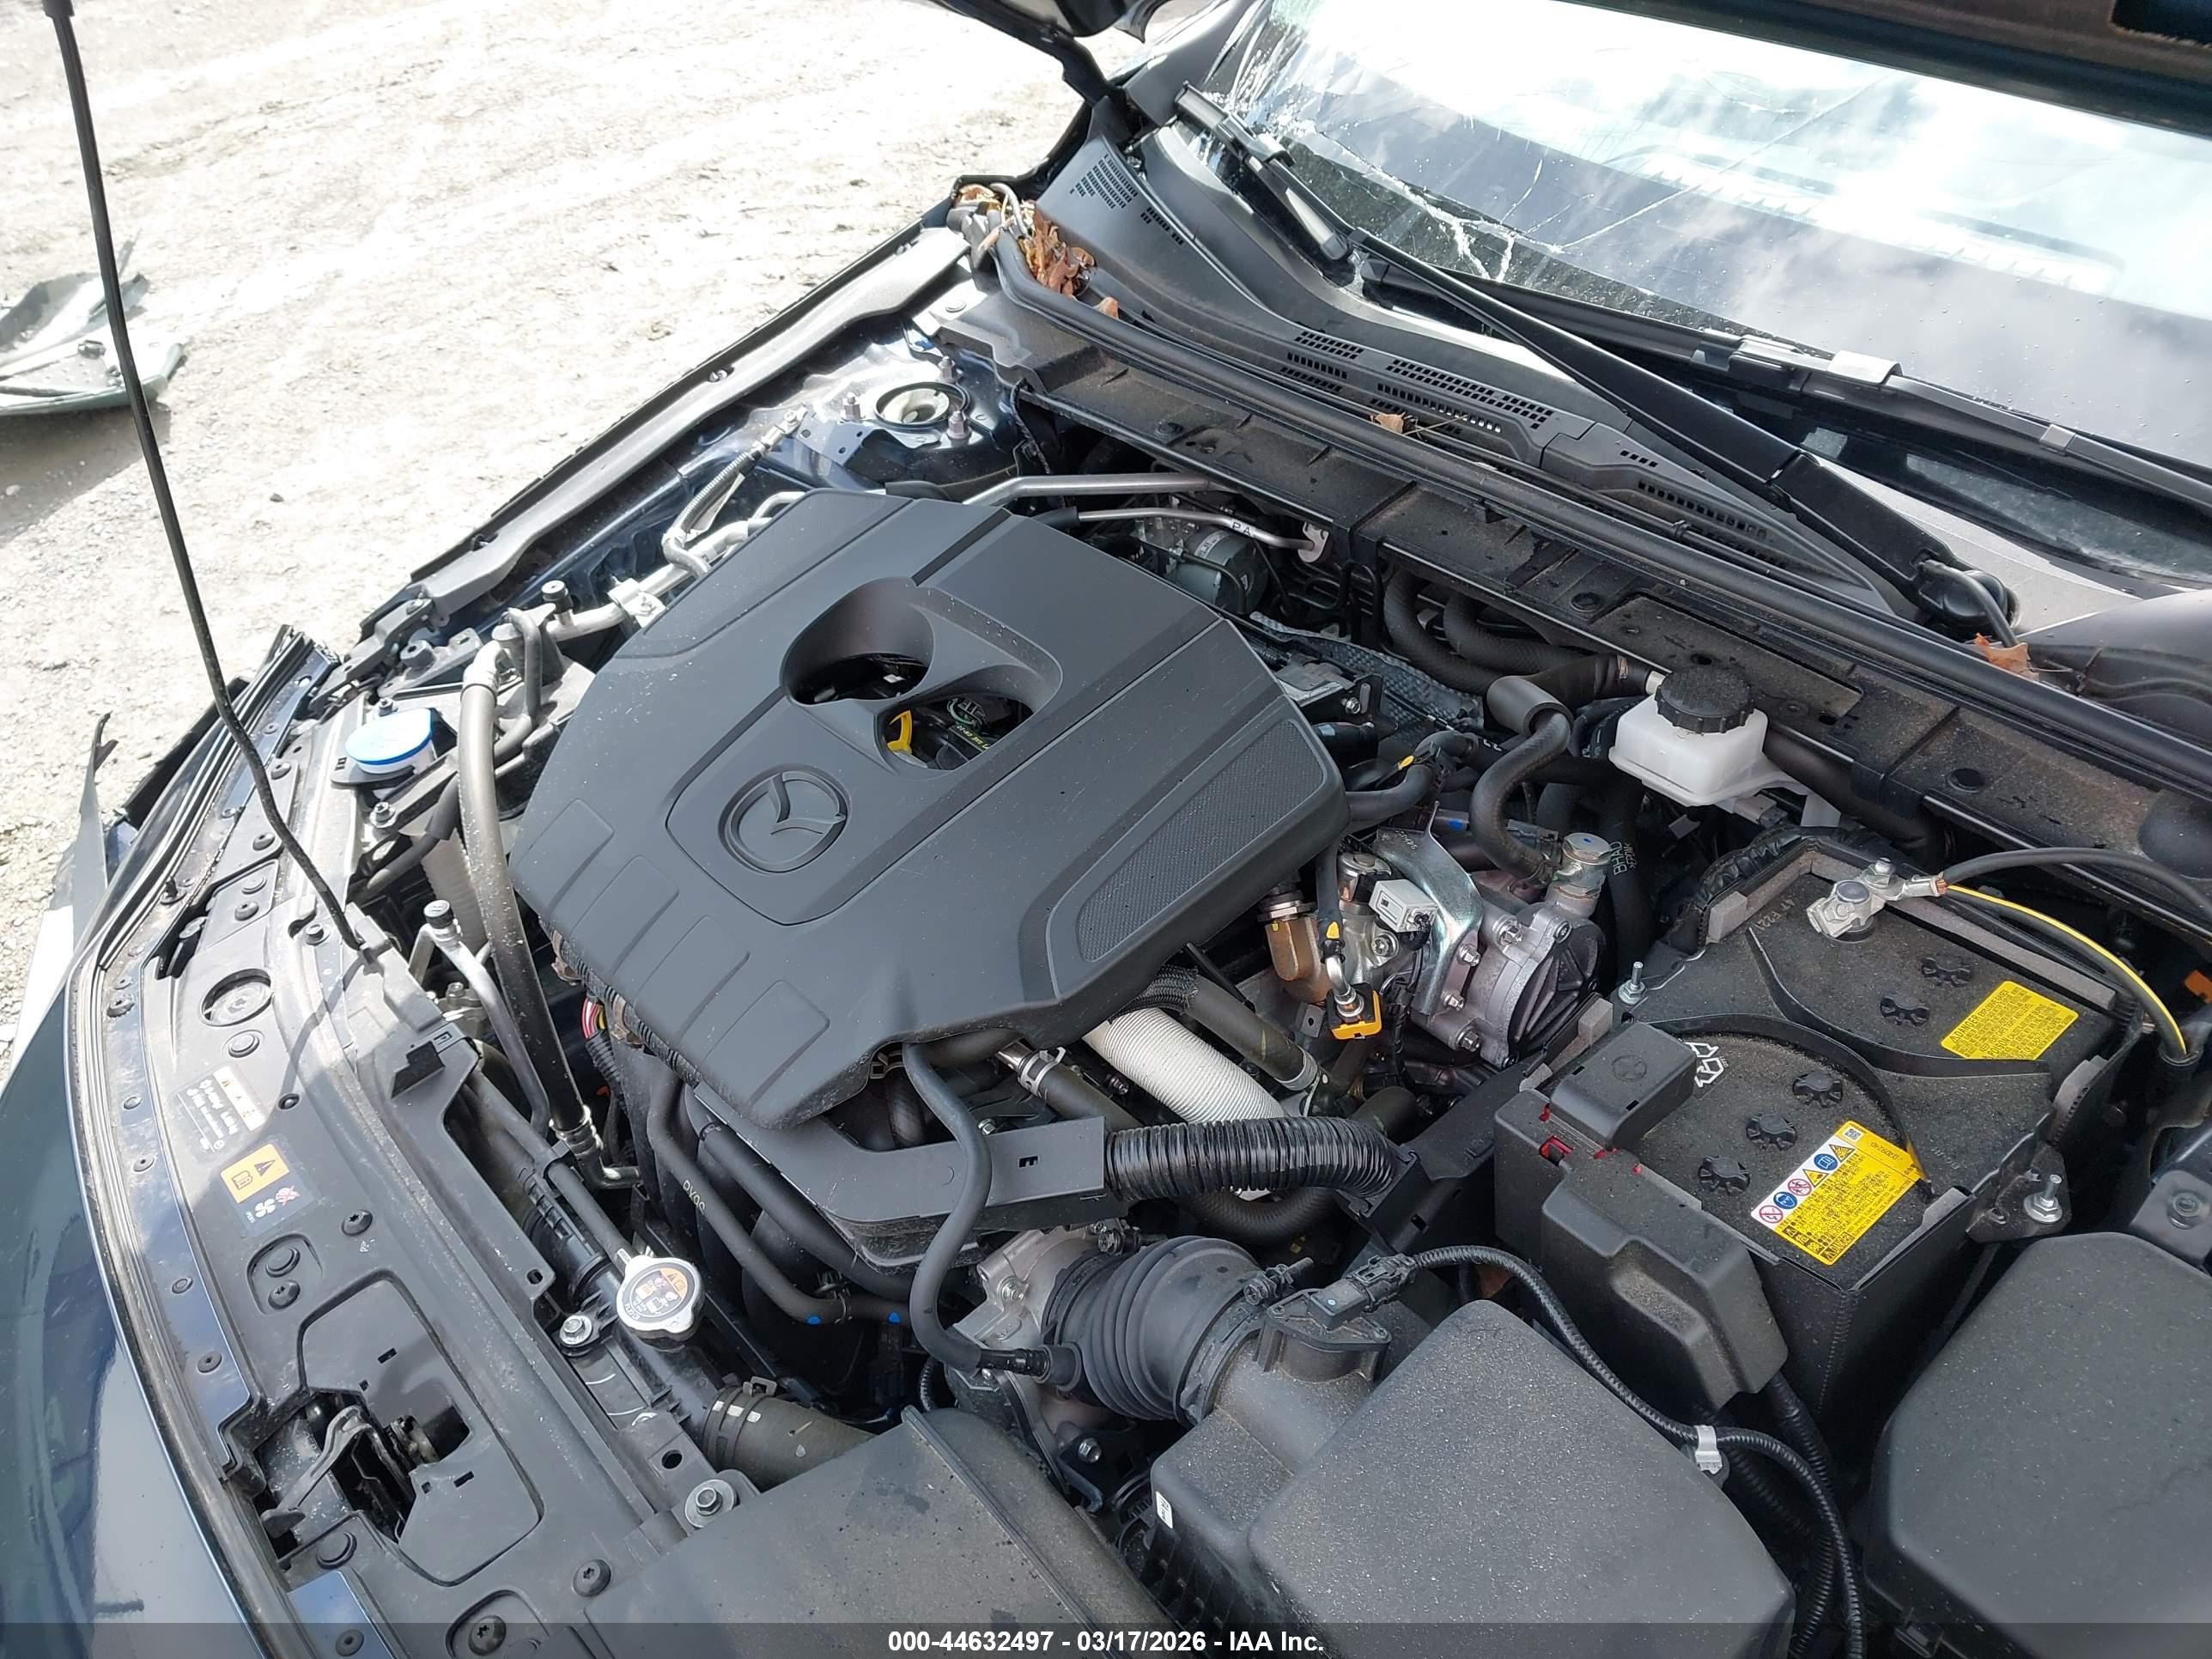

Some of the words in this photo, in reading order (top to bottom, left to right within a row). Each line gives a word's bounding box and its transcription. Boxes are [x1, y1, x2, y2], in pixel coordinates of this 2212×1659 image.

[1610, 842, 1626, 874] BHAD
[1955, 1014, 1981, 1039] DANGER
[1986, 1036, 2011, 1057] POISON
